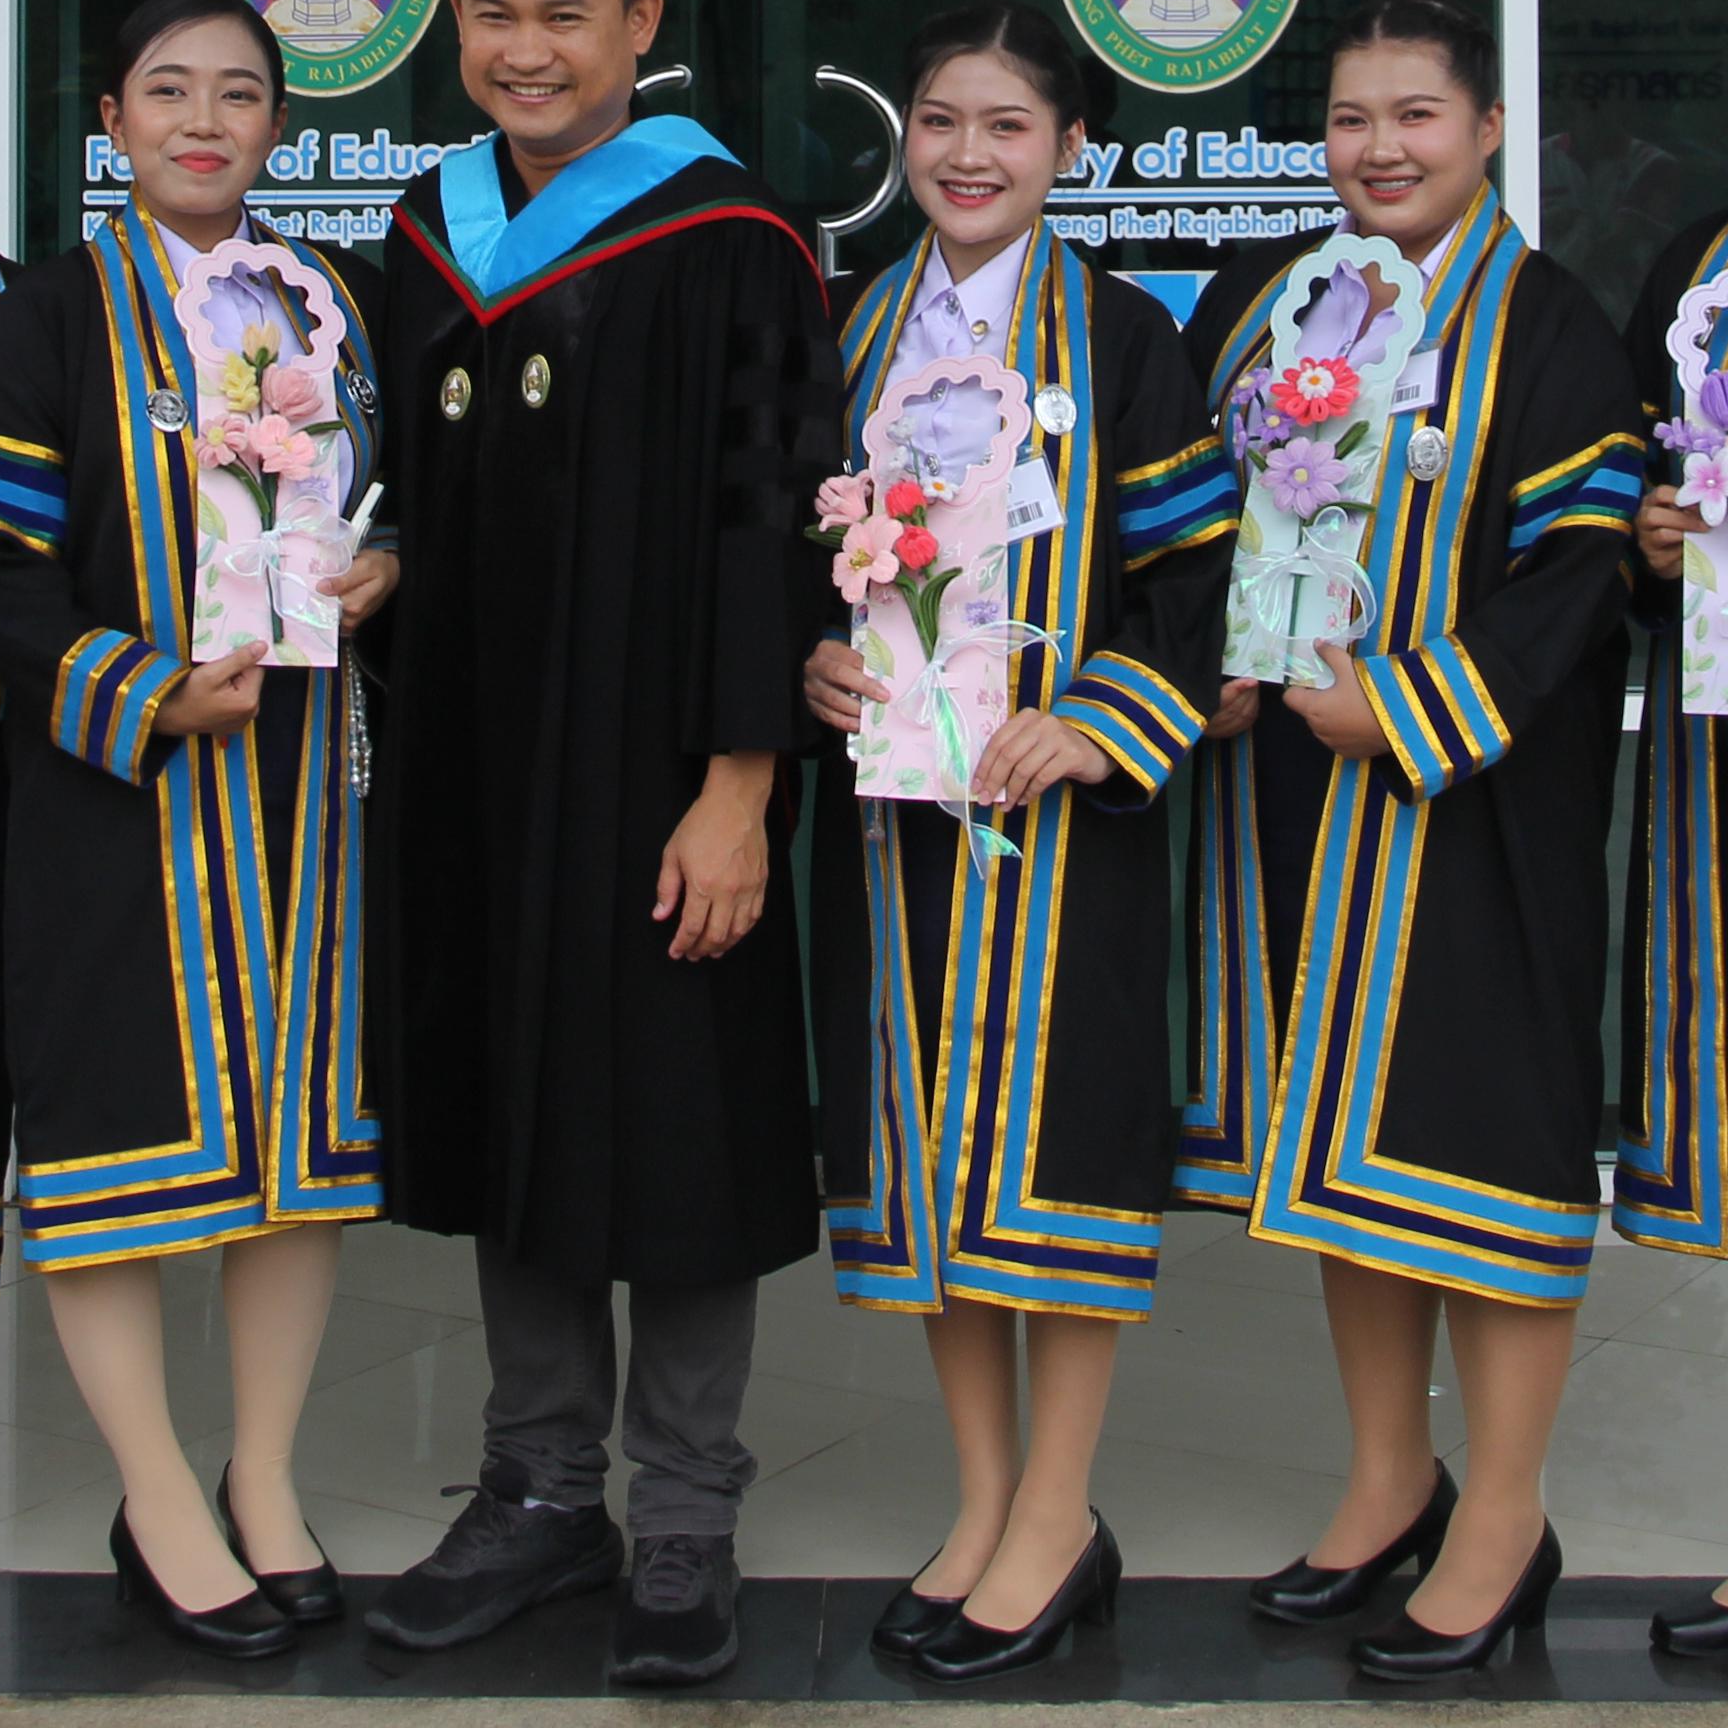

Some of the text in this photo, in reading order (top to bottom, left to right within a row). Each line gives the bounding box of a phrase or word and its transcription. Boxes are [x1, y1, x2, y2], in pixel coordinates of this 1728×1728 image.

[308, 25, 405, 84] RAJABHAT
[1104, 31, 1153, 69] PHET
[1165, 22, 1265, 80] RAJABHAT
[267, 130, 320, 178] of
[1133, 128, 1186, 177] of
[1111, 207, 1171, 237] Phet
[1175, 206, 1296, 245] Rajabhat
